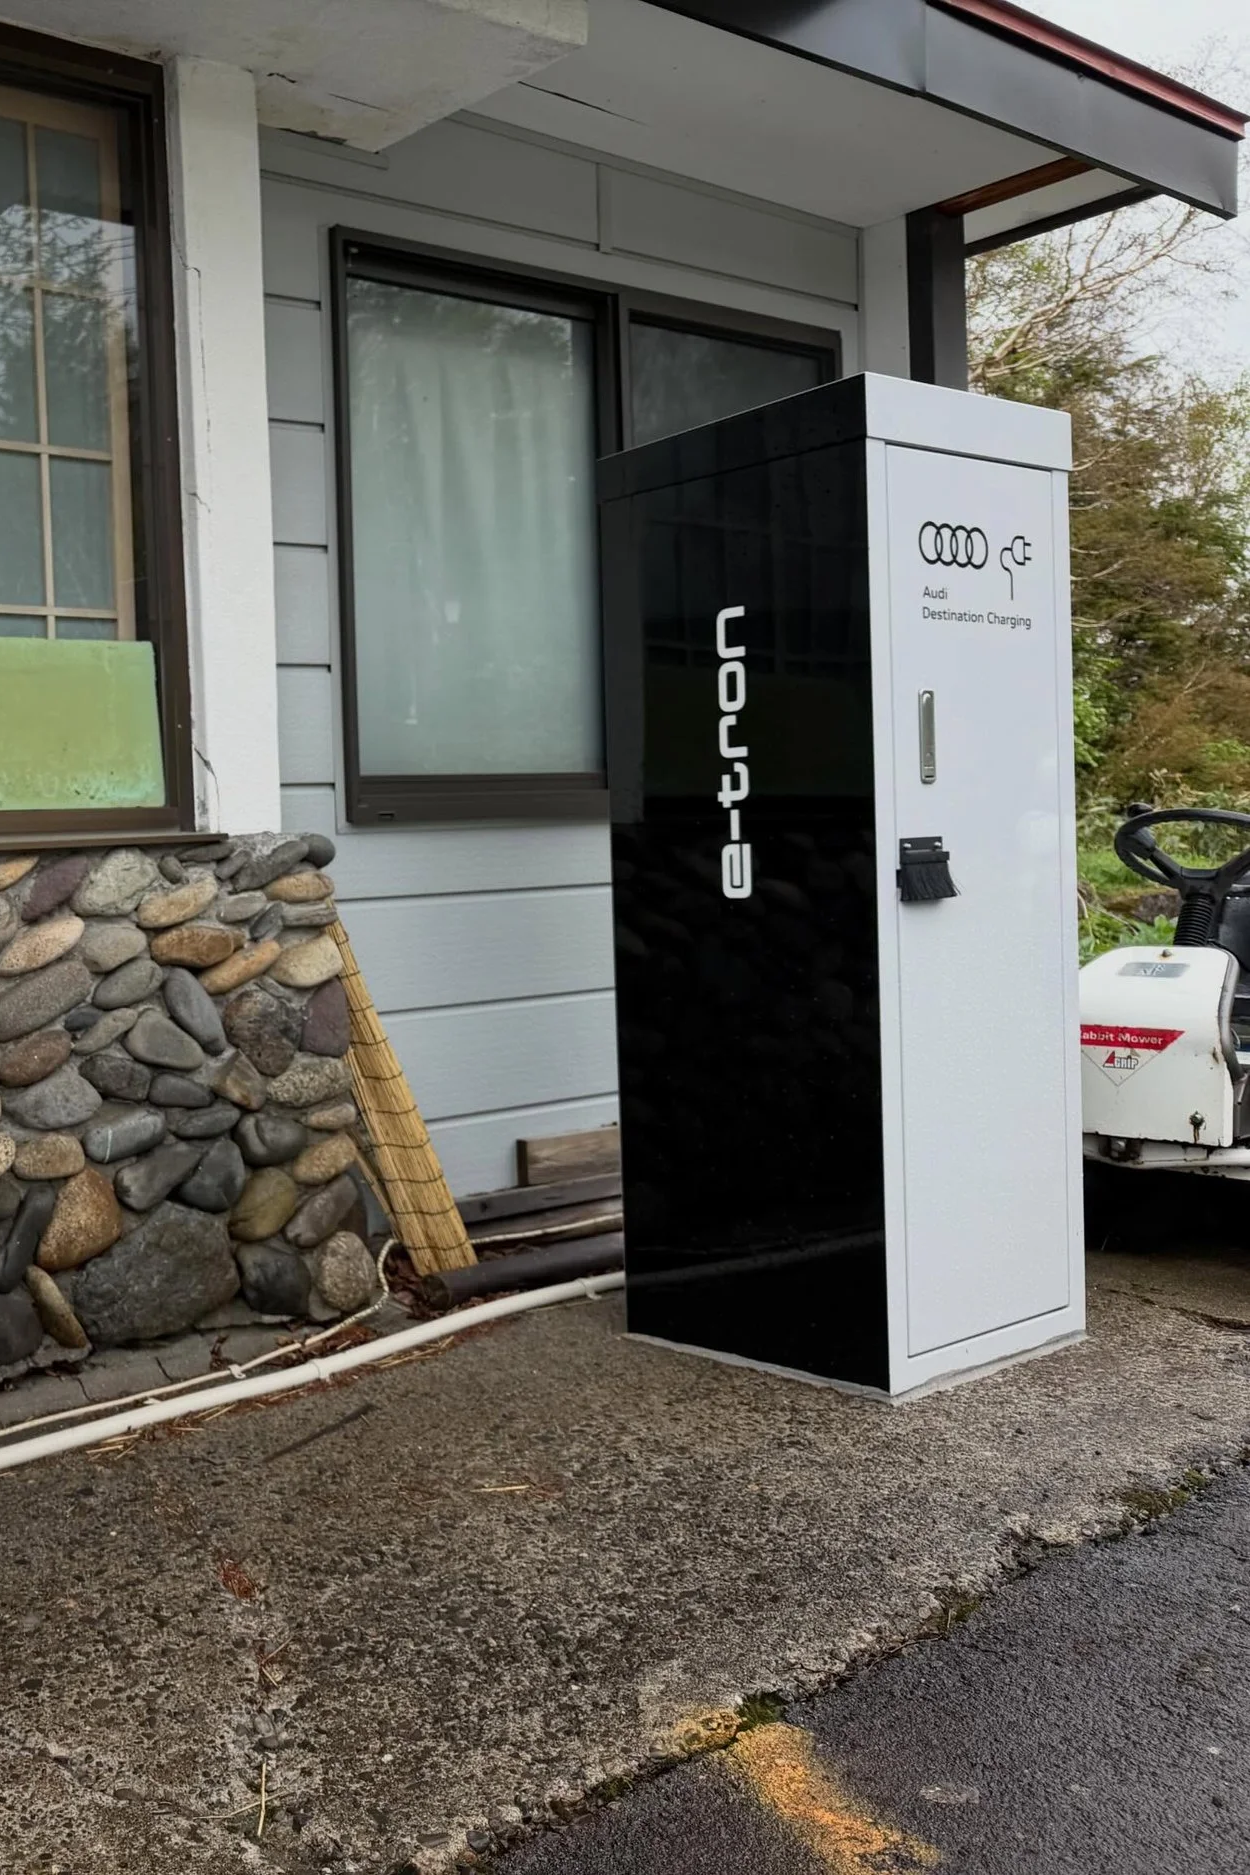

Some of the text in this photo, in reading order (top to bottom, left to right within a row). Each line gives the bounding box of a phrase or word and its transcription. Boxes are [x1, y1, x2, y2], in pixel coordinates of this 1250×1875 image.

[922, 586, 948, 600] Audi
[922, 606, 1032, 630] Destination Charging
[715, 604, 753, 900] e-tron
[1080, 1031, 1164, 1046] abbit Mower
